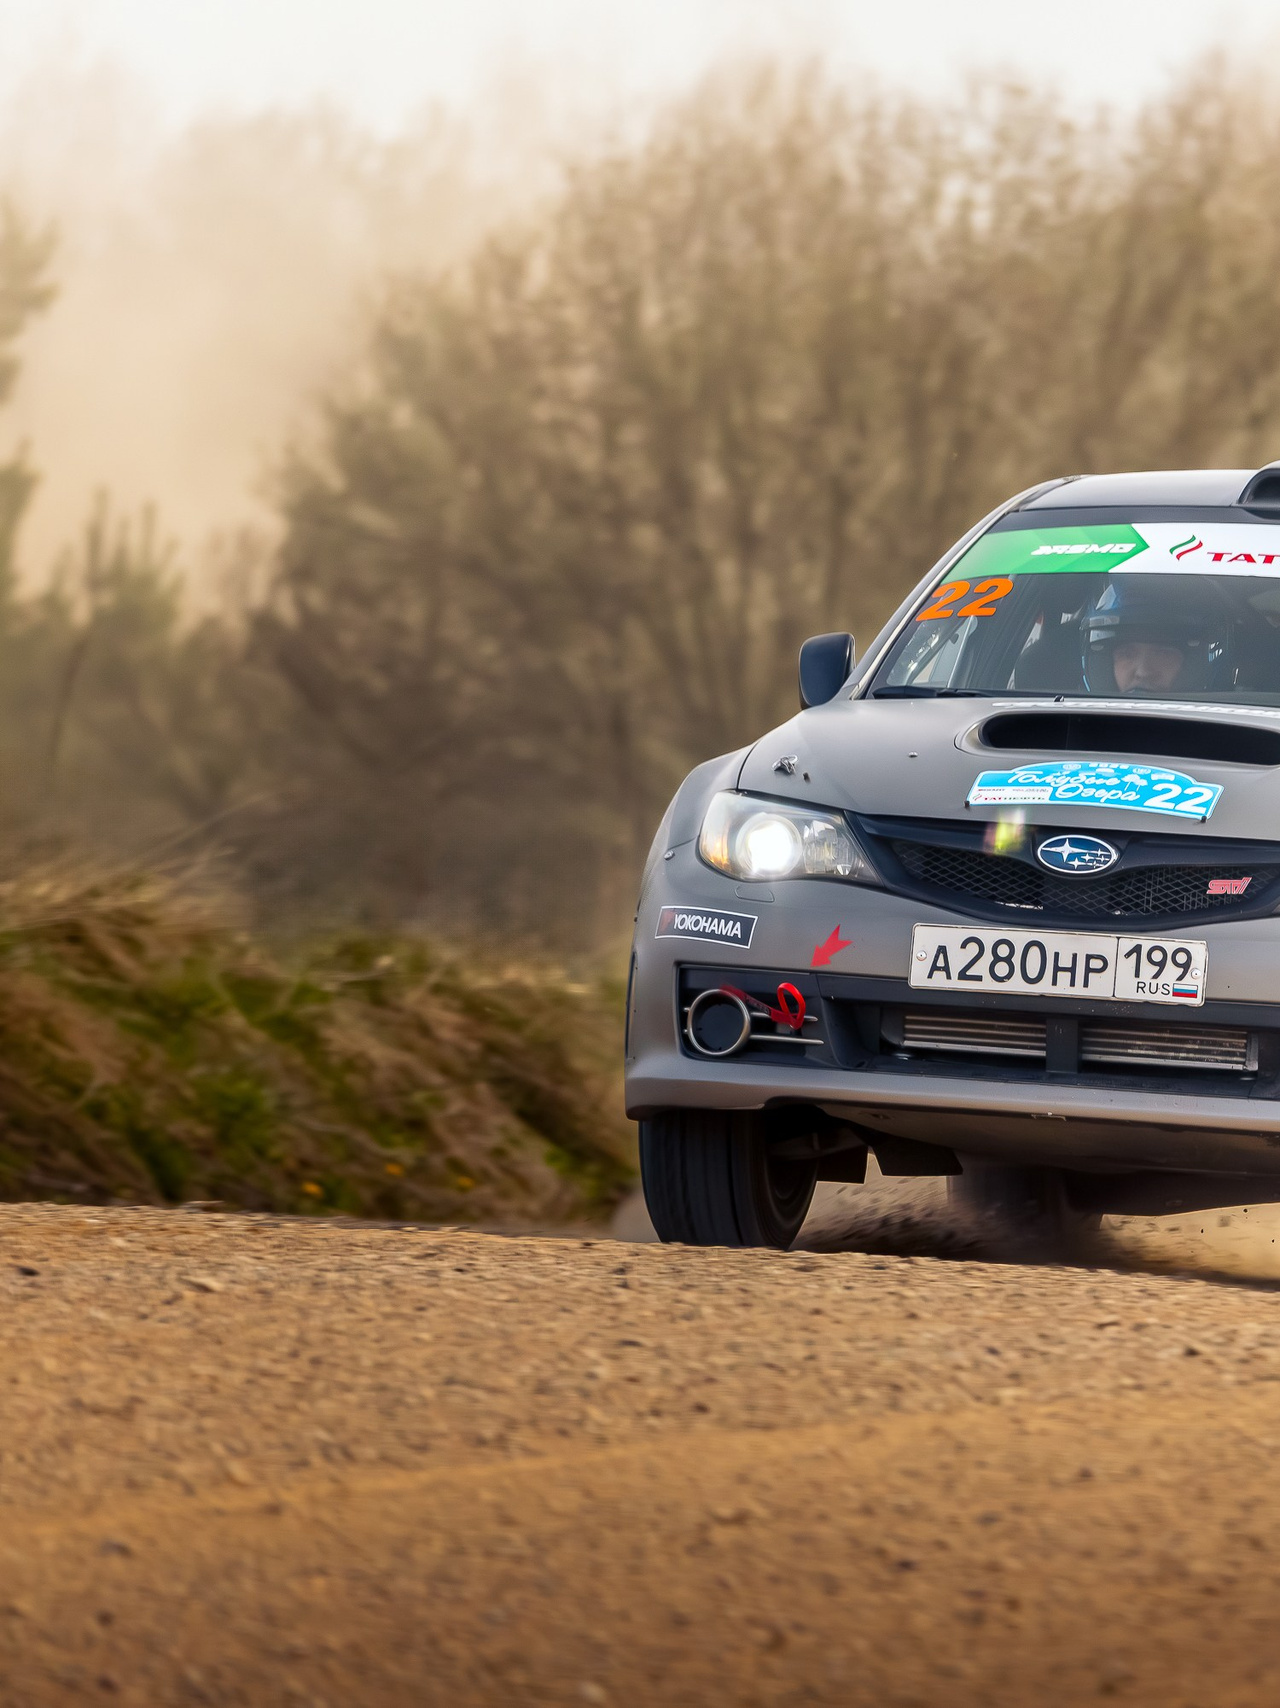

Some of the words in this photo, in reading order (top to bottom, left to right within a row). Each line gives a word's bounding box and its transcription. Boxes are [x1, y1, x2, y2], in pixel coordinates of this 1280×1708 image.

[915, 578, 1014, 622] 22
[1143, 783, 1214, 814] 22
[673, 913, 742, 939] YOKOHAMA
[927, 936, 1109, 988] А280НР
[1123, 943, 1193, 982] 199
[1136, 981, 1171, 996] RUS
